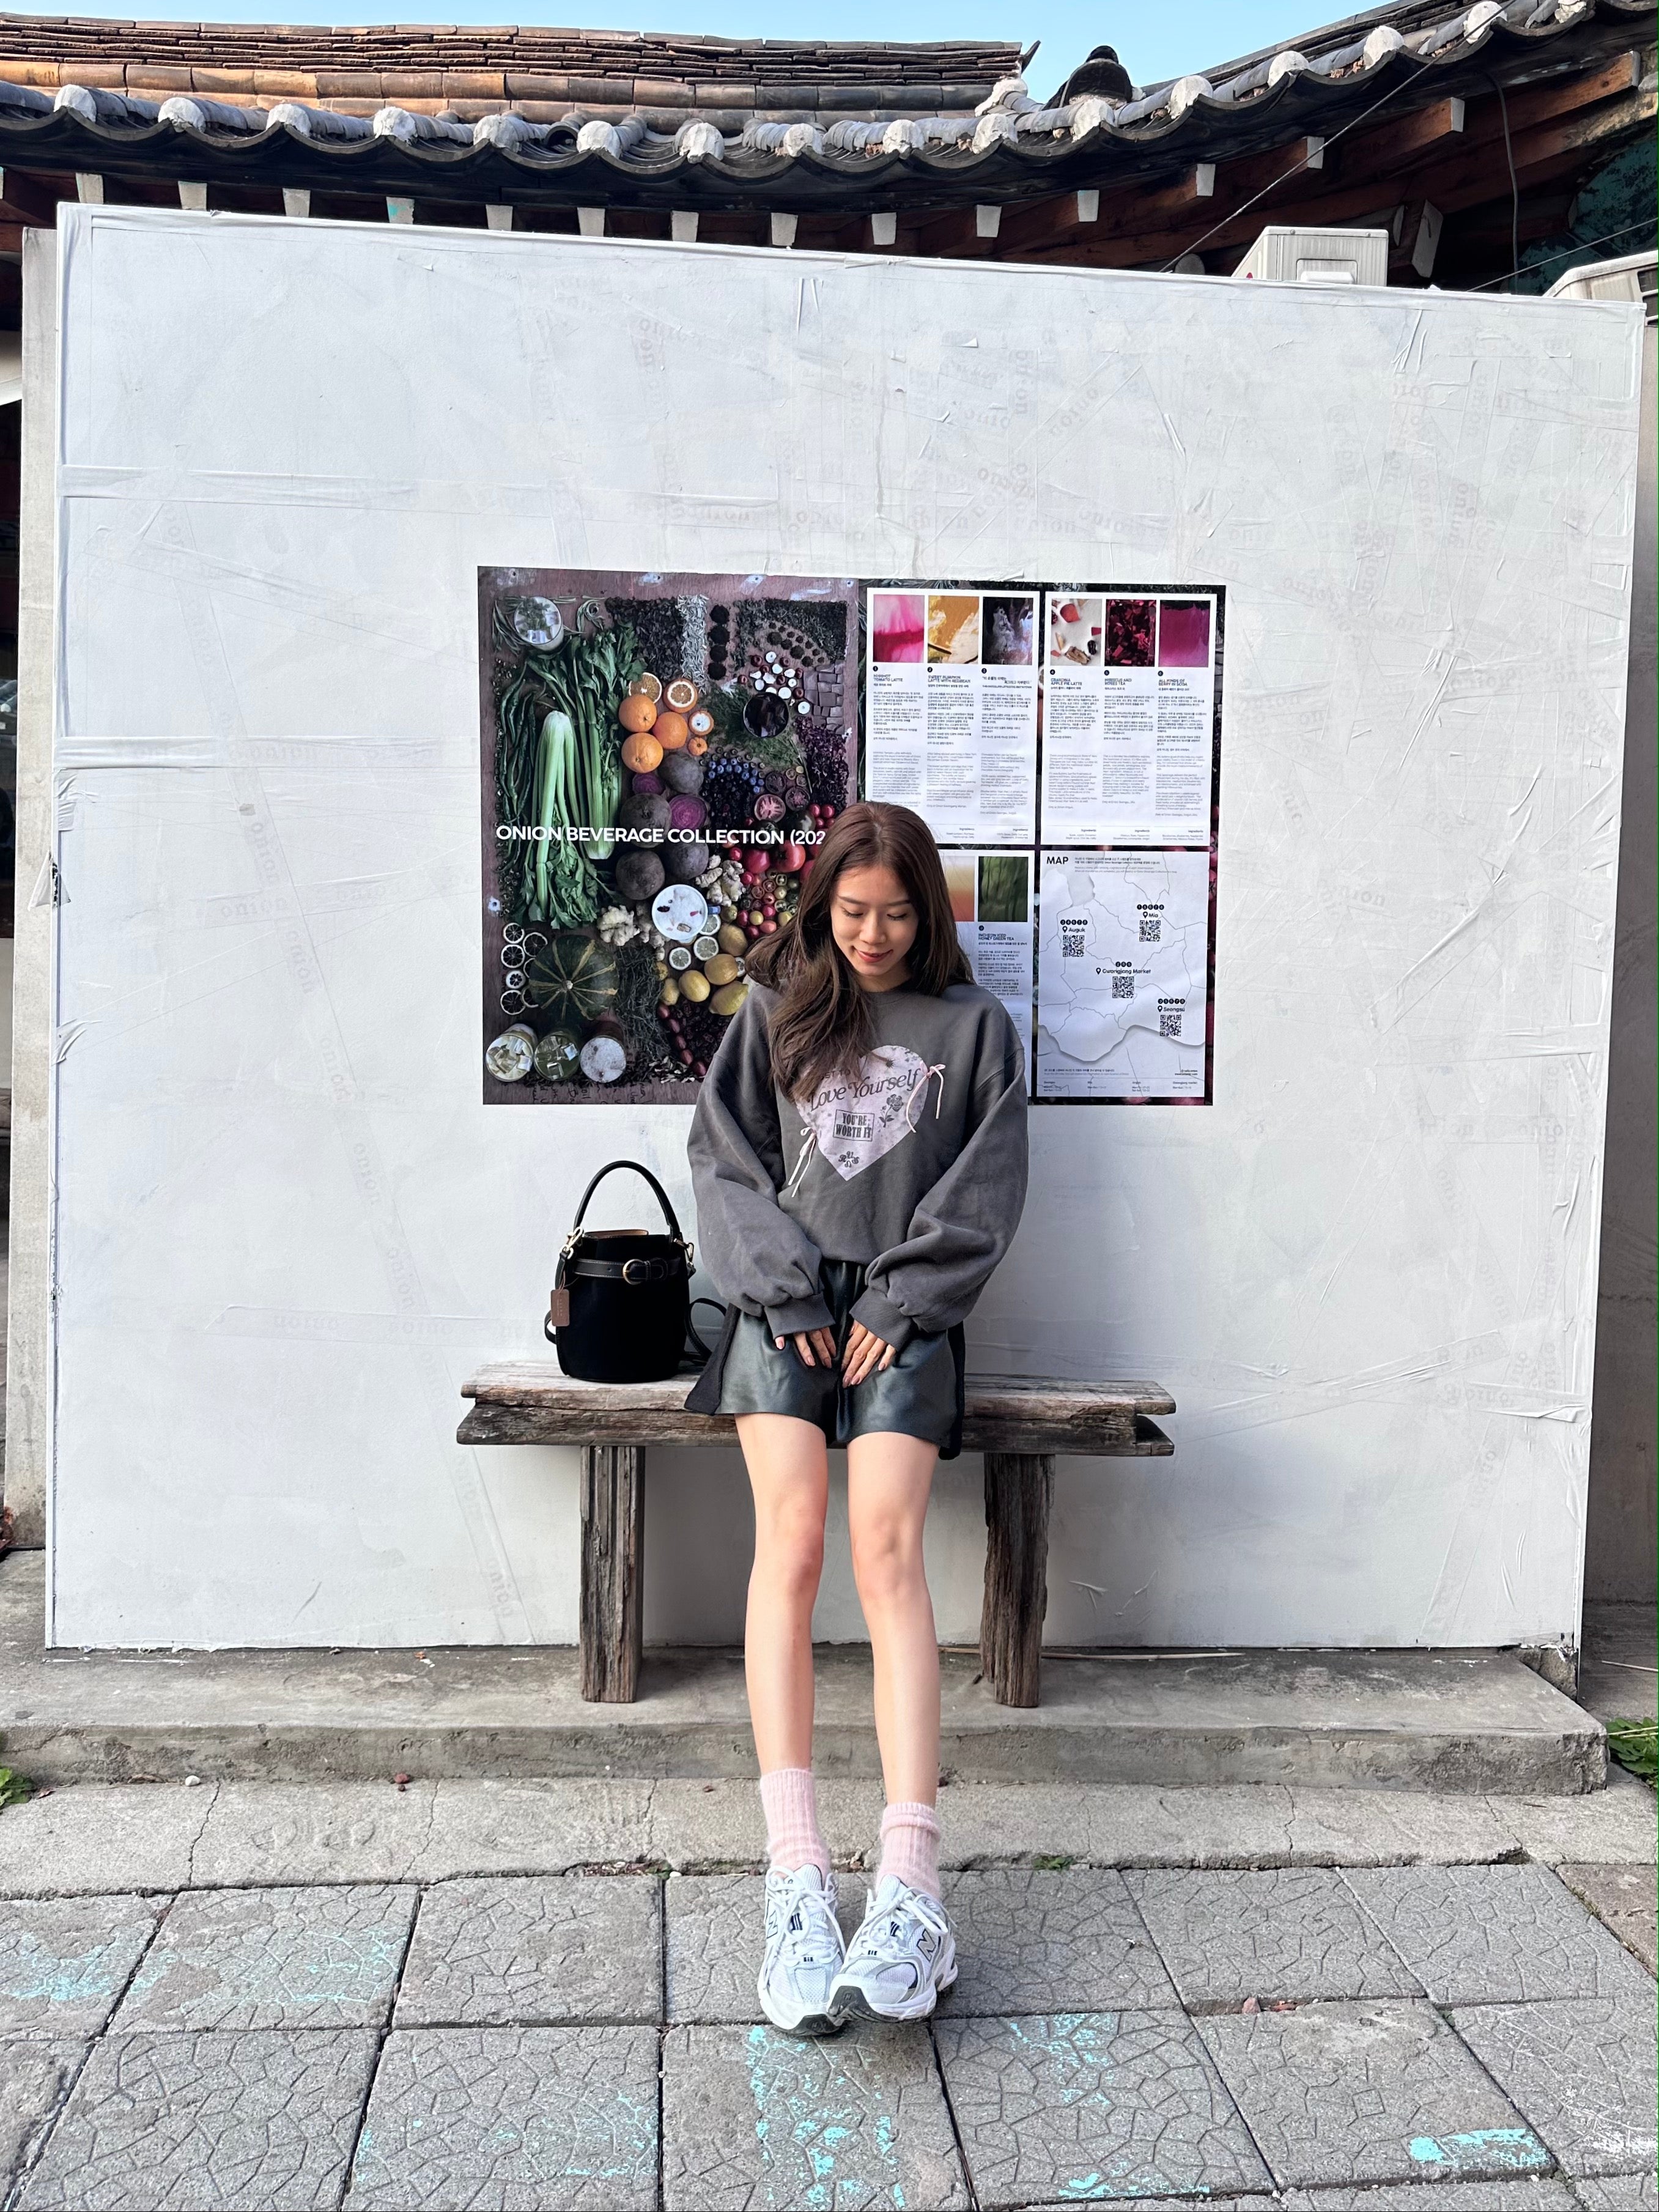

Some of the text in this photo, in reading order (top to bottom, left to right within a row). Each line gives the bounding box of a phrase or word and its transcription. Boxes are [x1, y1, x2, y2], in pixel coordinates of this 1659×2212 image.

[495, 826, 561, 840] ONION
[566, 827, 664, 843] BEVERAGE
[668, 828, 785, 845] COLLECTION
[252, 821, 280, 884] onion
[1046, 856, 1069, 865] MAP
[221, 897, 288, 919] onion
[808, 1068, 922, 1112] Love Yourself
[842, 1112, 867, 1126] YOU'RE
[835, 1125, 872, 1138] WORTH IT
[354, 1142, 382, 1207] onion
[917, 1928, 937, 1962] N
